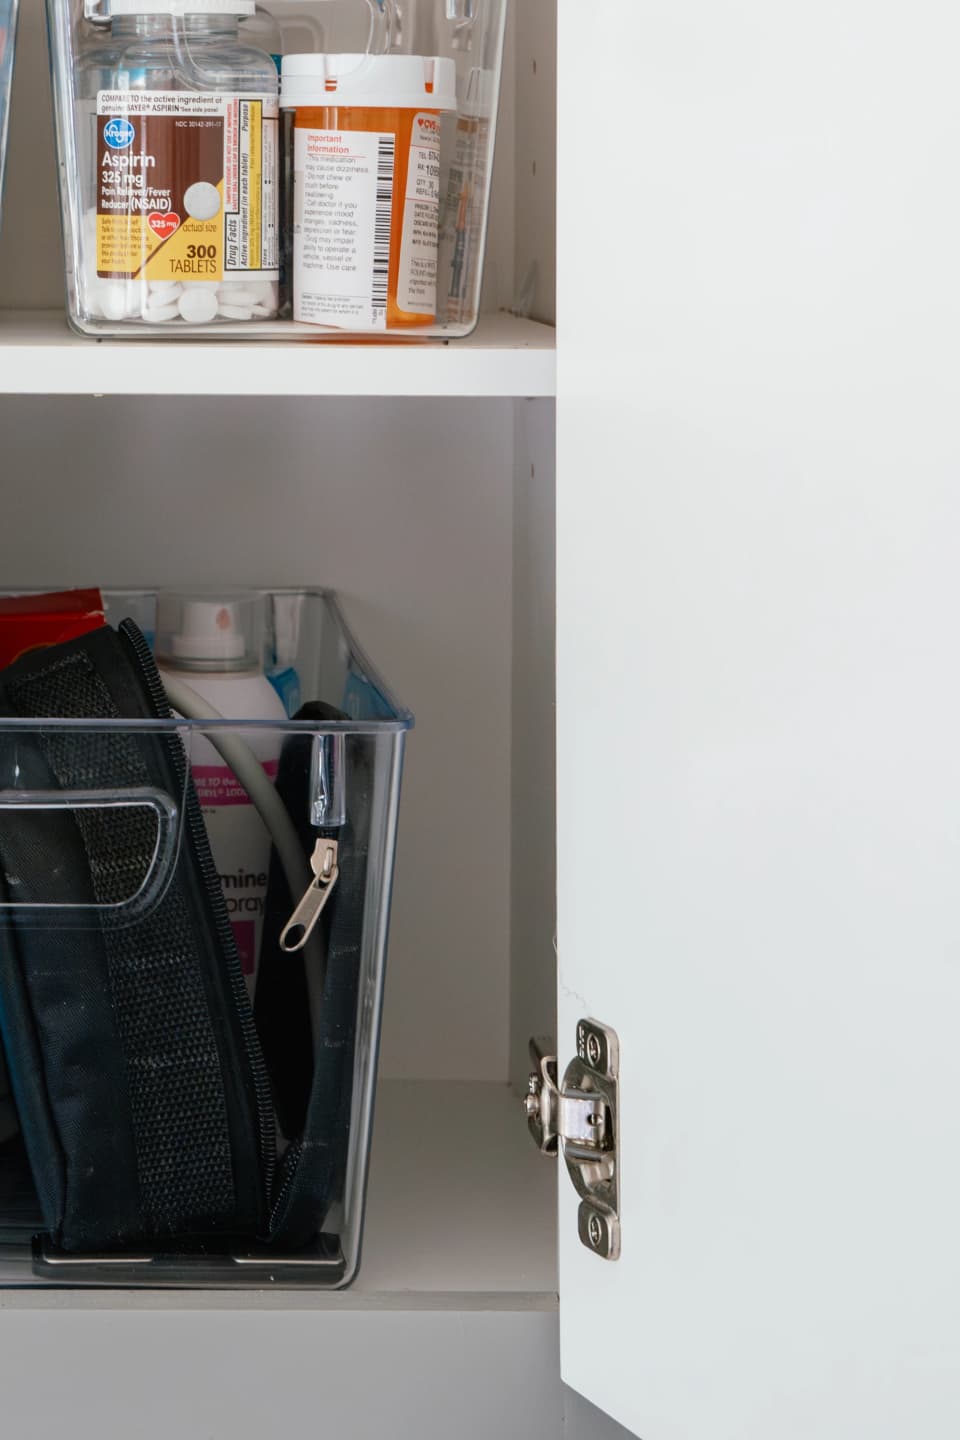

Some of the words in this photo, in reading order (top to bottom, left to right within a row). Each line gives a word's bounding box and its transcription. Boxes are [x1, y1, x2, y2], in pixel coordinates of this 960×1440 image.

[131, 95, 139, 103] TO
[141, 94, 152, 102] the
[154, 95, 176, 103] active
[178, 96, 214, 105] ingredient
[152, 104, 180, 112] ASPIRIN
[104, 124, 132, 143] Kroger
[307, 136, 342, 144] Important
[307, 145, 350, 153] information
[102, 151, 156, 171] Aspirin
[102, 171, 120, 183] 325
[124, 174, 144, 187] mg
[102, 186, 116, 196] Pain
[117, 186, 170, 197] Reliever/Fever
[102, 200, 129, 208] Reducer
[131, 198, 172, 212] (NSAID)
[152, 220, 166, 228] 325
[166, 222, 177, 230] mg
[183, 224, 204, 232] actual
[206, 224, 217, 232] size
[228, 220, 237, 242] Facts
[240, 208, 248, 242] ingredient
[187, 244, 216, 258] 300
[228, 245, 238, 266] Drug
[240, 242, 248, 266] Active
[170, 259, 216, 273] TABLETS
[219, 868, 267, 888] mine
[225, 897, 264, 916] pray
